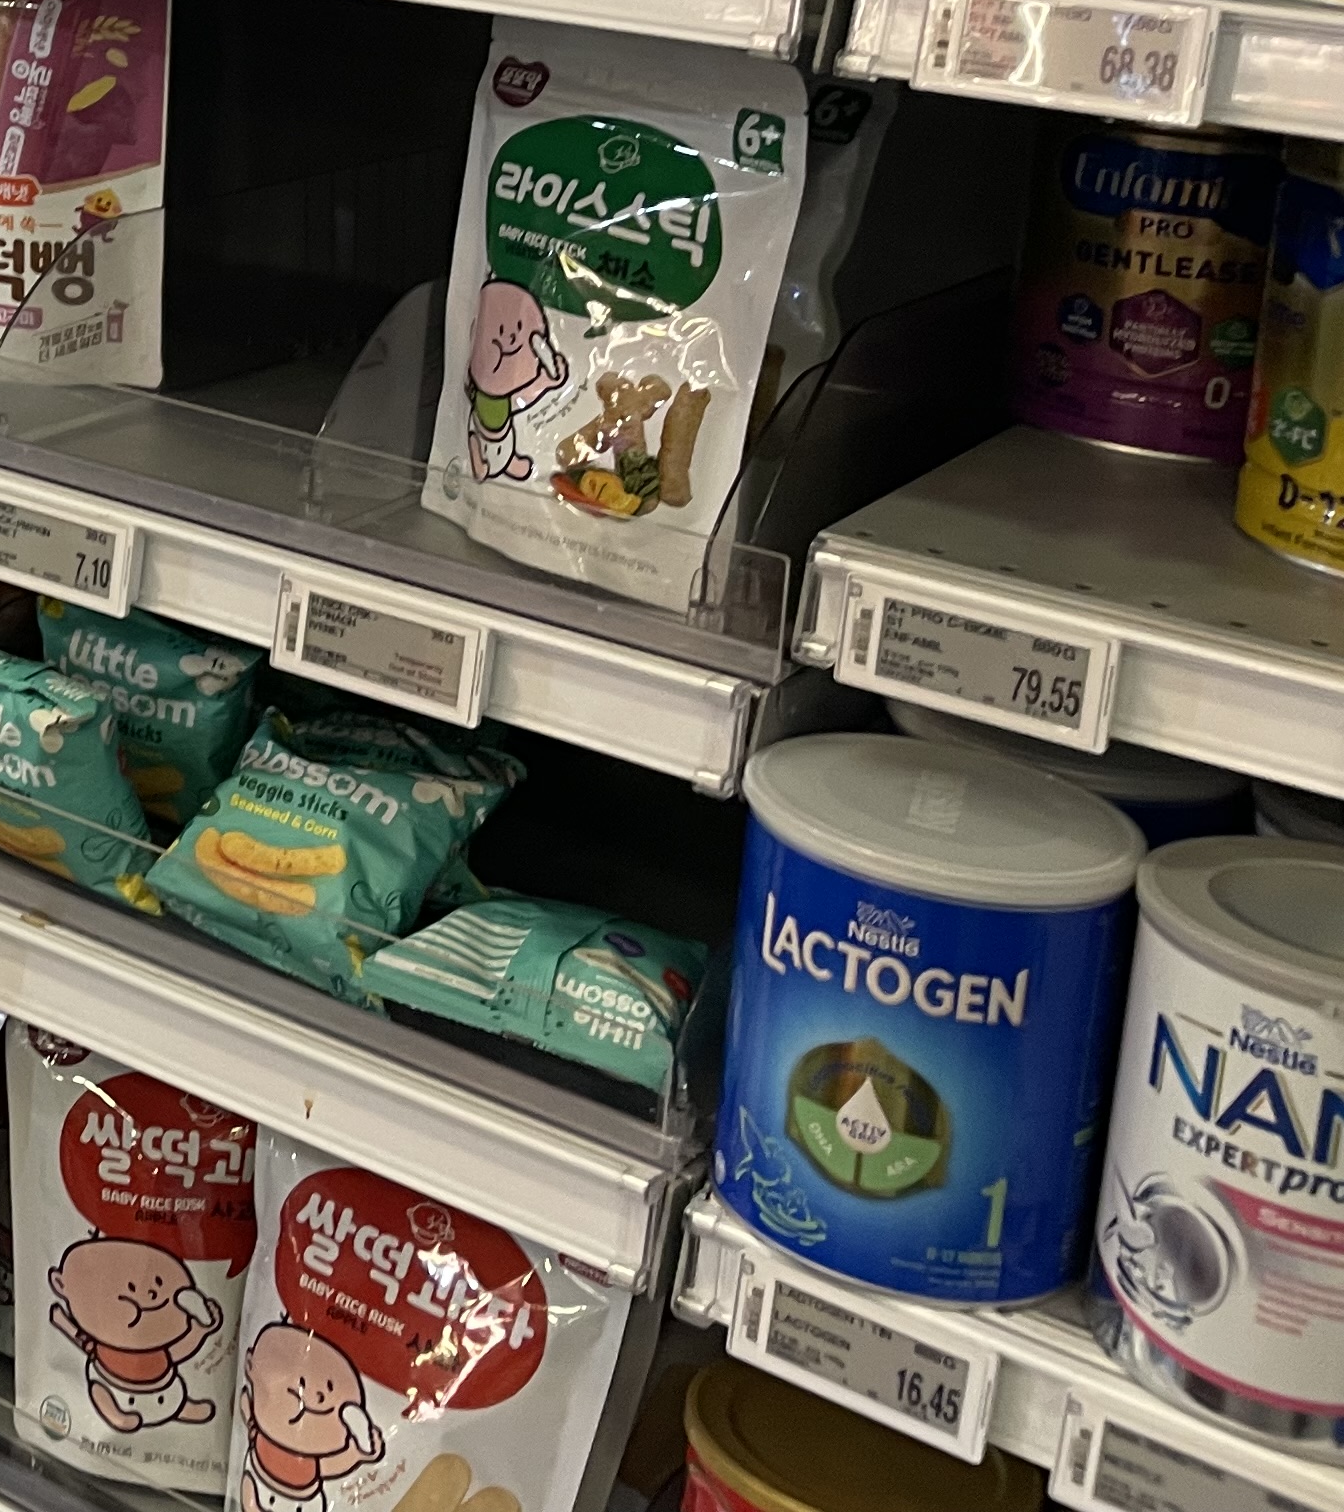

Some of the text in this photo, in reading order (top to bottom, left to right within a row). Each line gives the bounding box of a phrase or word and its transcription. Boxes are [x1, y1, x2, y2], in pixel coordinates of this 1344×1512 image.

[1098, 44, 1179, 93] 68.38
[736, 110, 781, 154] 6+
[1073, 150, 1228, 212] Enfami
[494, 160, 714, 268] 라이스스틱
[1138, 216, 1195, 241] PRO
[499, 223, 587, 261] BABY RICE STICK
[74, 551, 111, 590] 7.10
[68, 628, 161, 691] little
[1011, 665, 1082, 718] 79.55
[237, 771, 349, 823] veggie sticks
[241, 739, 406, 828] blossom
[229, 792, 288, 830] Seaweed
[306, 818, 339, 841] Corn
[760, 891, 1032, 1029] LACTOGEN
[101, 1187, 138, 1207] BABY
[140, 1193, 172, 1211] RICE
[981, 1177, 1008, 1250] 1
[299, 1273, 405, 1339] BABY RICE RUSK
[895, 1368, 967, 1426] 16.45
